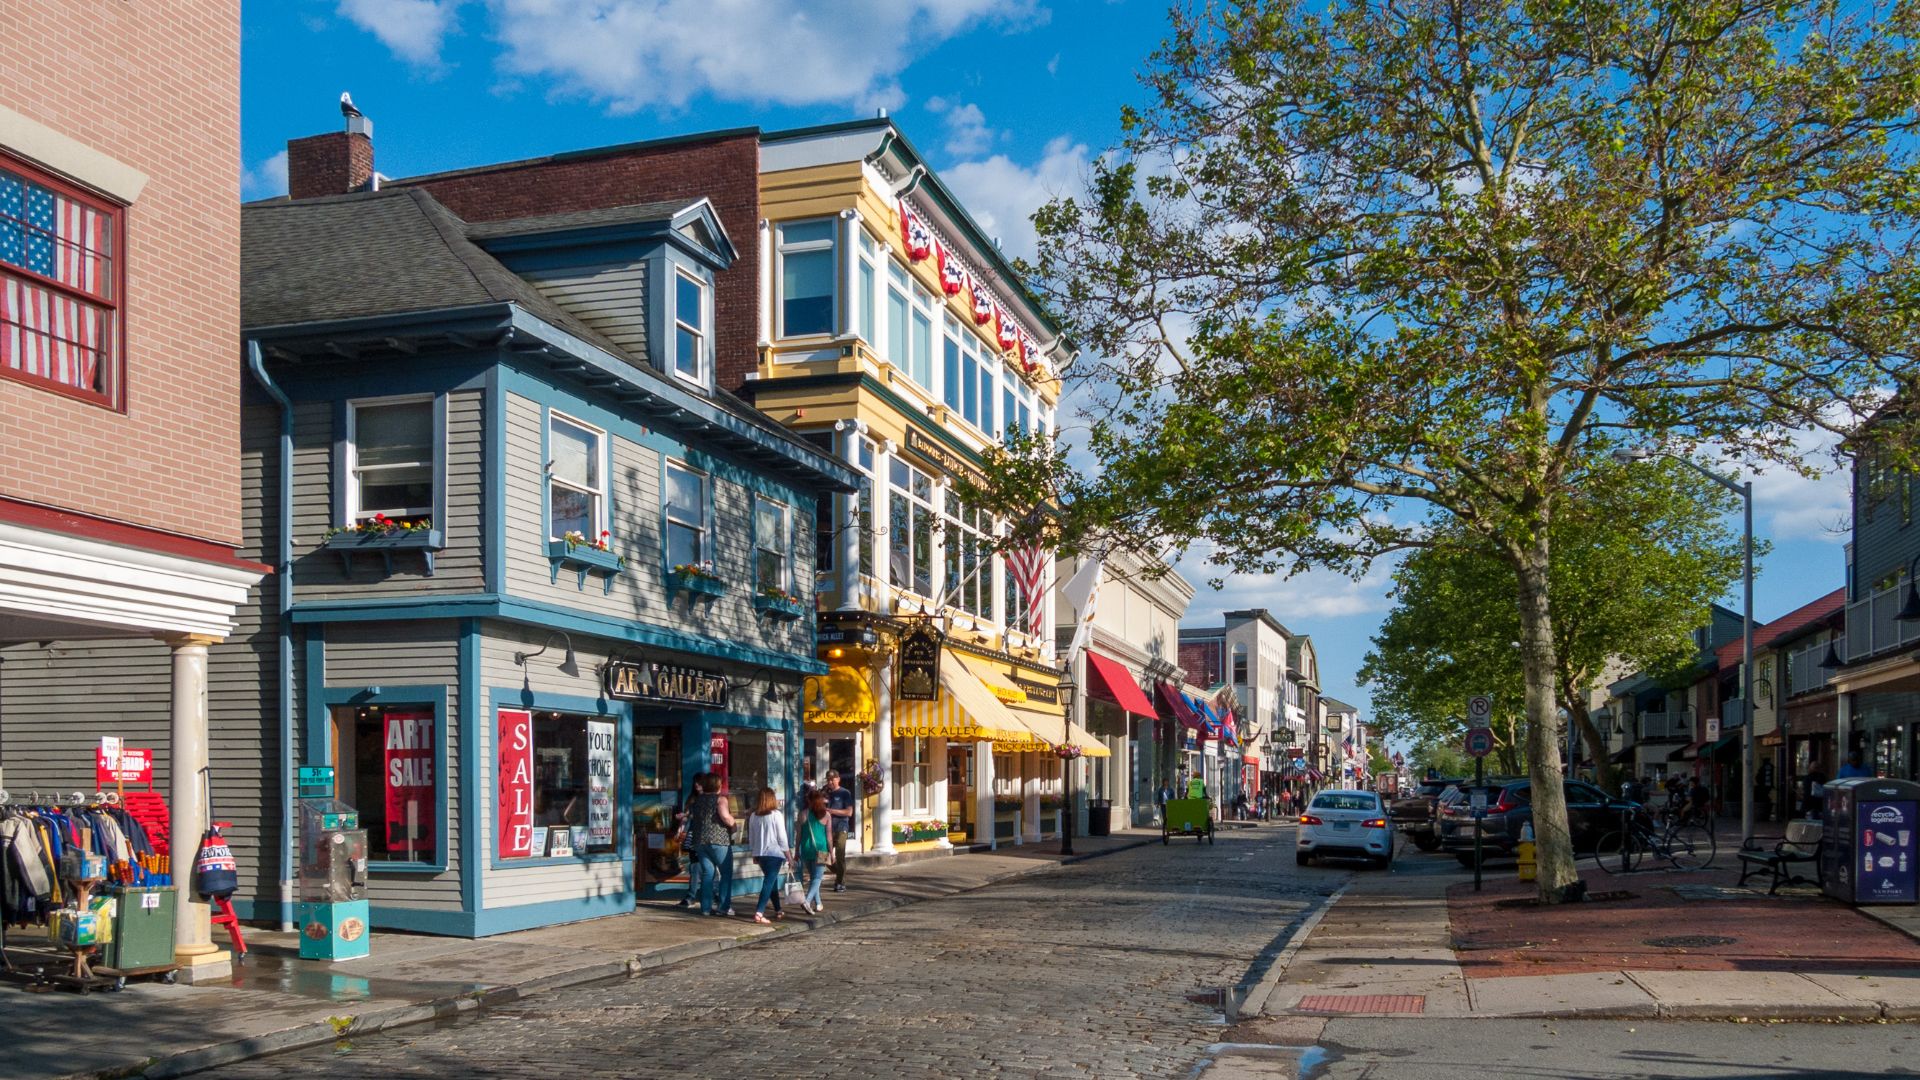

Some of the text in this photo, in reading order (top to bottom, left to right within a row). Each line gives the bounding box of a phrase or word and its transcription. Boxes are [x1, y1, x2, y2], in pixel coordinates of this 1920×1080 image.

[651, 663, 704, 677] EASIDE
[658, 672, 725, 704] GALLERY
[808, 710, 873, 720] BRICK ALLEY
[386, 719, 433, 750] ART
[897, 725, 979, 736] BRICK ALLEY
[589, 732, 612, 751] YOUR
[106, 756, 145, 771] LIFGUARD
[390, 758, 432, 787] SALE
[589, 759, 612, 777] CHOICE
[511, 723, 531, 851] SALE
